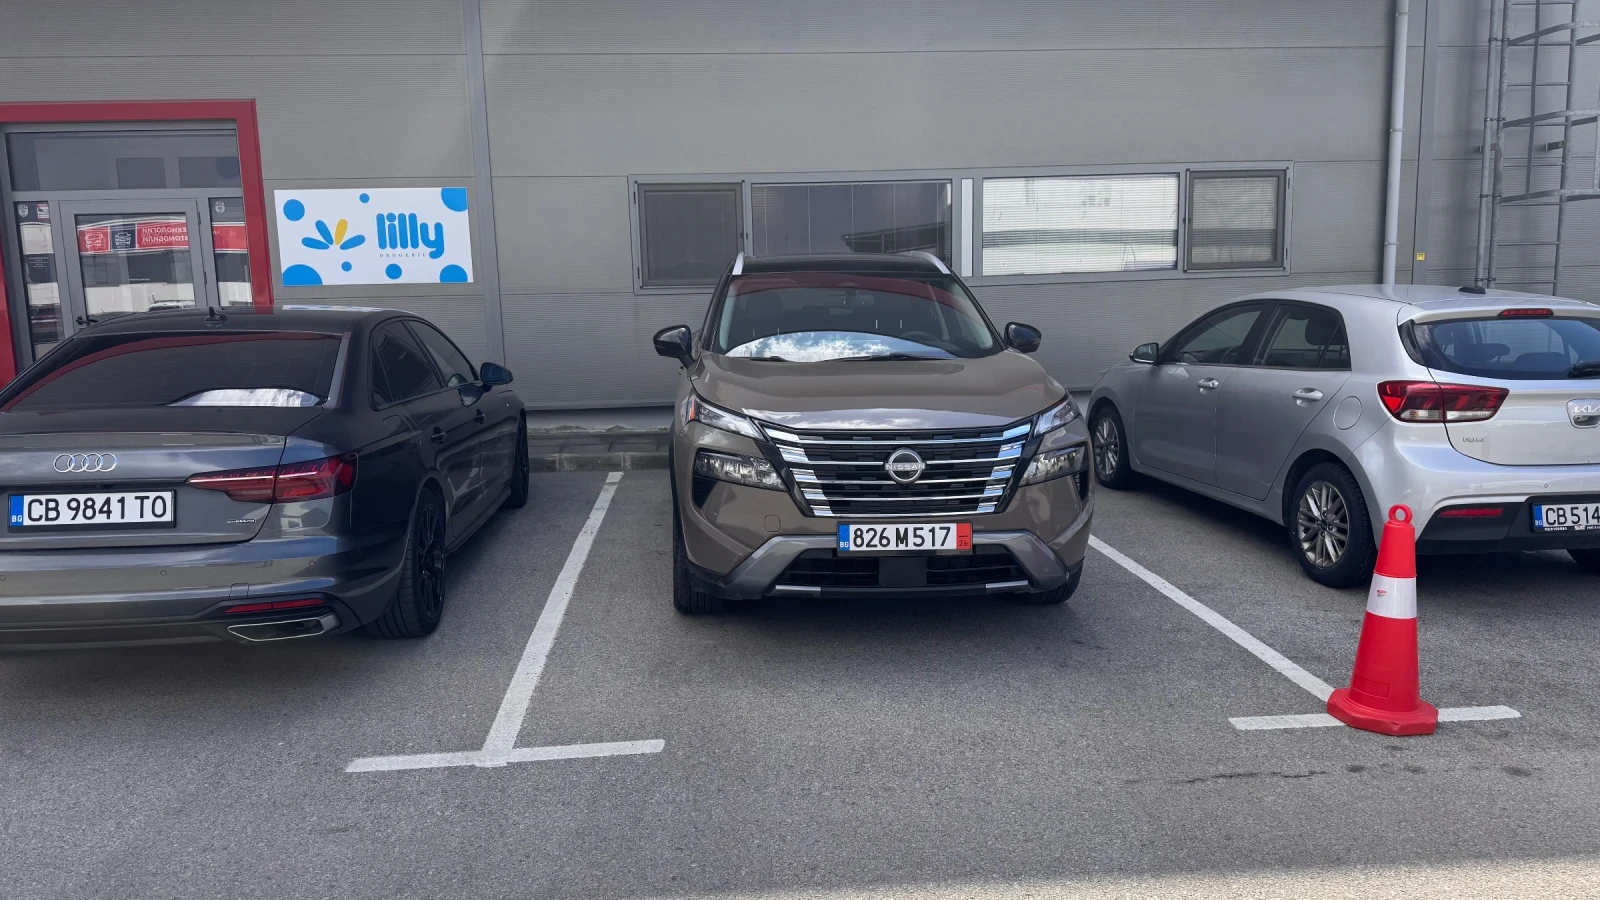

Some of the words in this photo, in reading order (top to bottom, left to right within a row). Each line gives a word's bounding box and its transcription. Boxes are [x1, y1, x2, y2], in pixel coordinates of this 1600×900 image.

[376, 212, 445, 260] lilly
[11, 514, 23, 523] BG
[27, 498, 60, 522] CB
[66, 496, 126, 521] 9841
[1545, 507, 1568, 526] CB
[852, 527, 891, 548] 826
[912, 526, 951, 547] 517
[958, 539, 969, 547] 26
